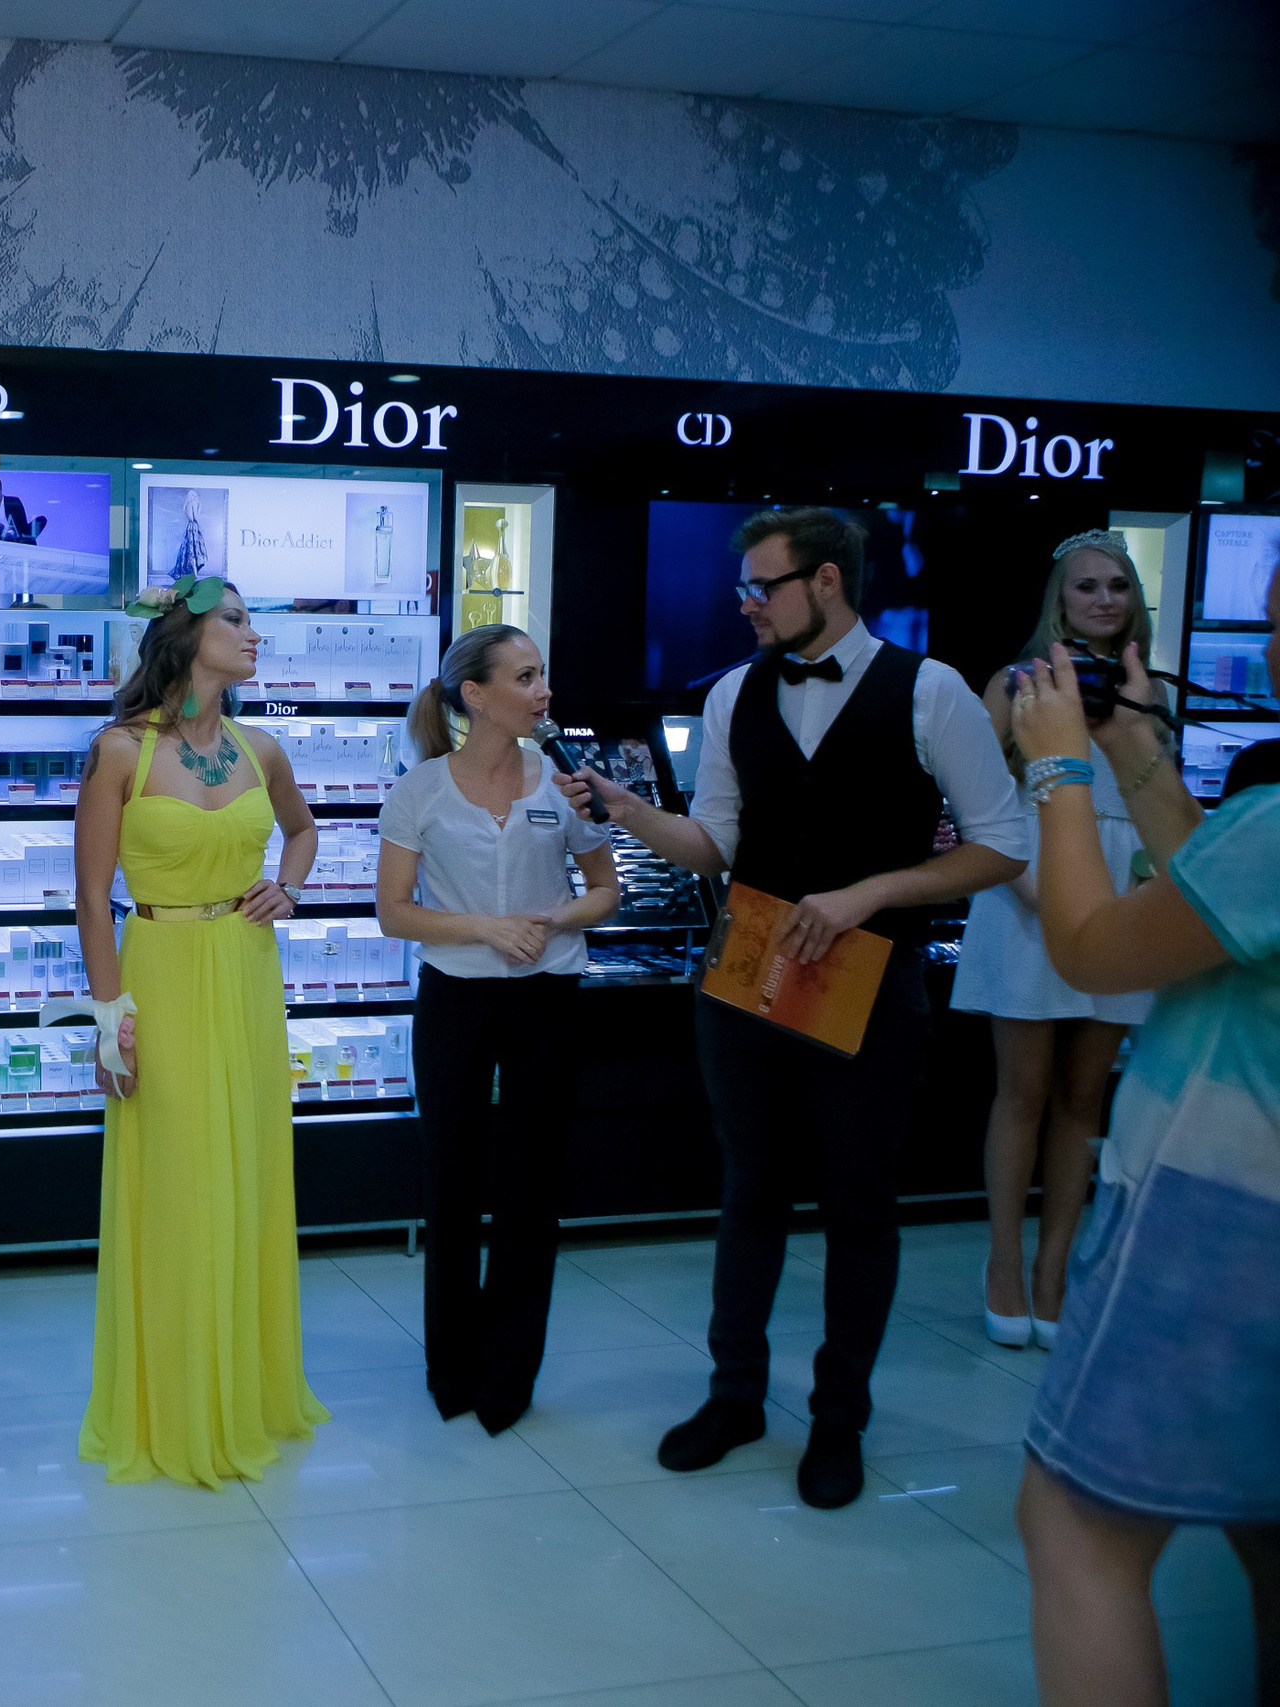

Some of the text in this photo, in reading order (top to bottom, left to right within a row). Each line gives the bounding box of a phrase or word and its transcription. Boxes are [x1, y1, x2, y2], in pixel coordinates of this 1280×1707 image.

[268, 375, 458, 450] Dior
[958, 413, 1114, 480] Dior
[238, 528, 335, 550] Dior Addict
[1214, 529, 1254, 539] CAPTURE
[1216, 538, 1251, 548] TOTALE
[265, 702, 298, 715] Dior
[563, 727, 595, 737] ГЛАЗА
